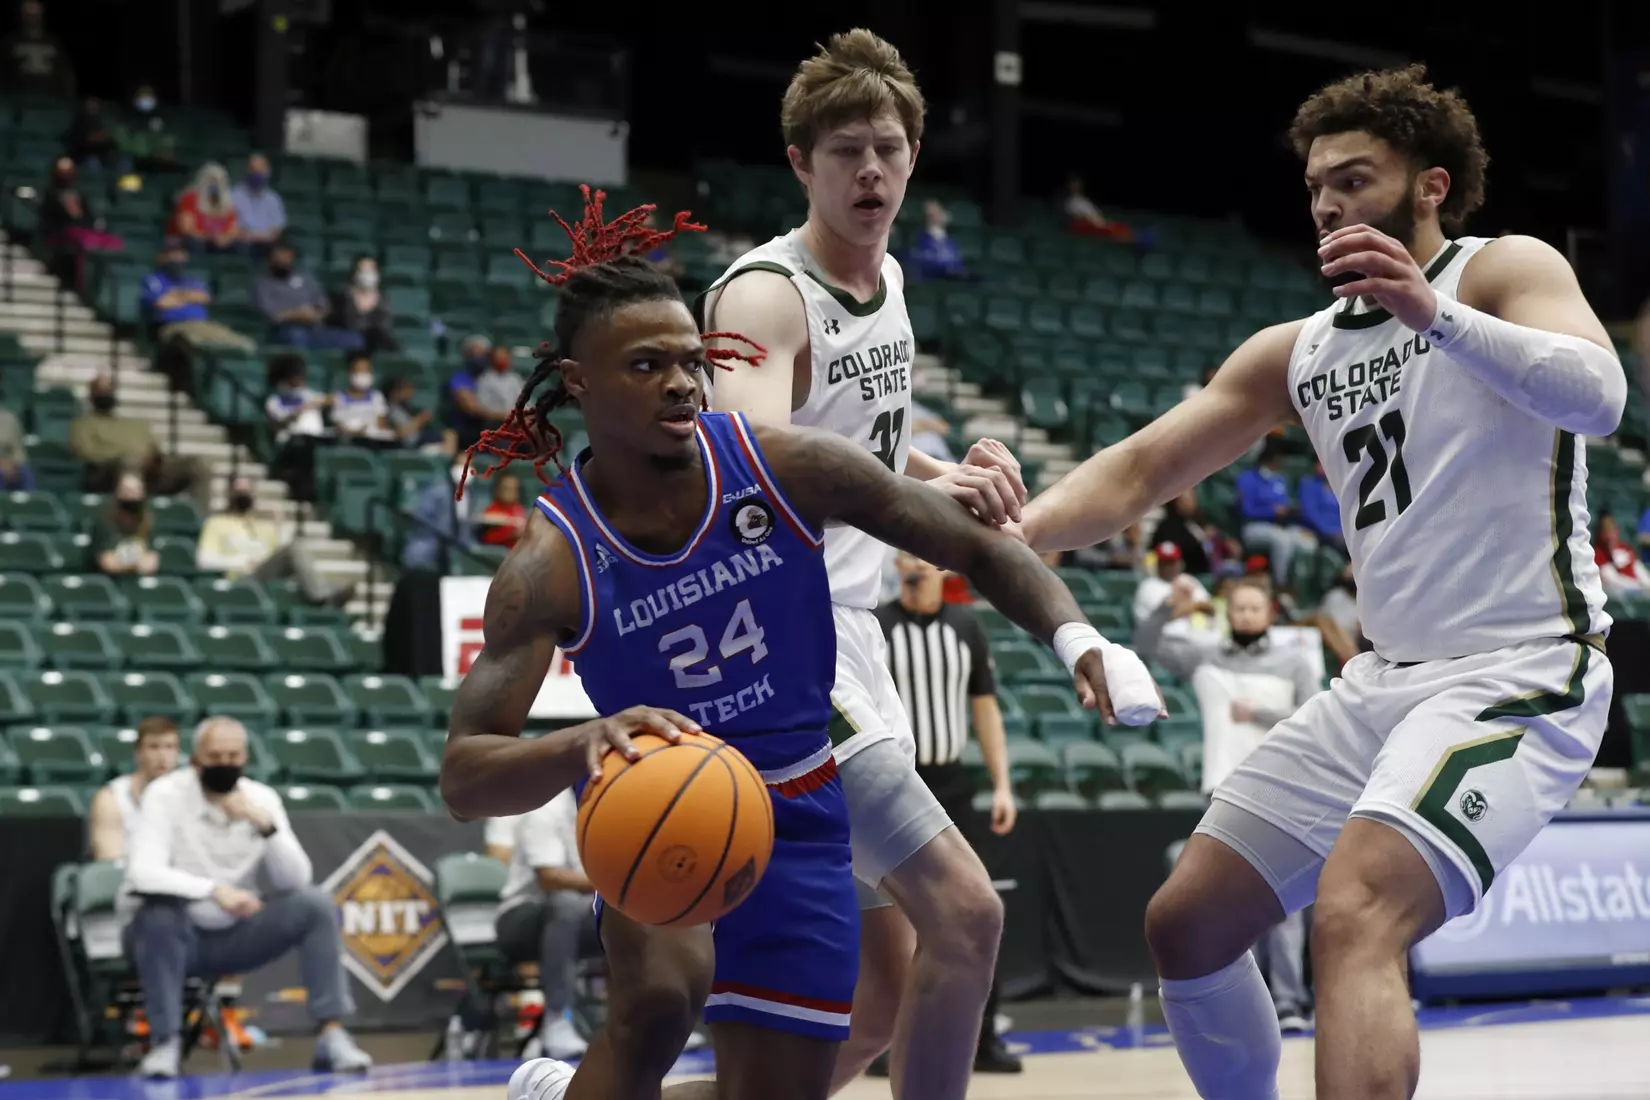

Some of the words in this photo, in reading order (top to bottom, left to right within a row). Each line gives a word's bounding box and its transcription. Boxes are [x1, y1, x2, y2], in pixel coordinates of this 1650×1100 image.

[827, 340, 910, 385] COLORADO
[859, 367, 907, 402] STATE
[1297, 332, 1431, 409] COLORADO
[1326, 369, 1402, 421] STATE
[1342, 408, 1413, 531] 21
[612, 543, 784, 637] LOUISIANA
[657, 598, 769, 689] 24
[688, 673, 775, 727] TECH
[342, 900, 431, 935] NIT
[1500, 860, 1650, 925] Allstat
